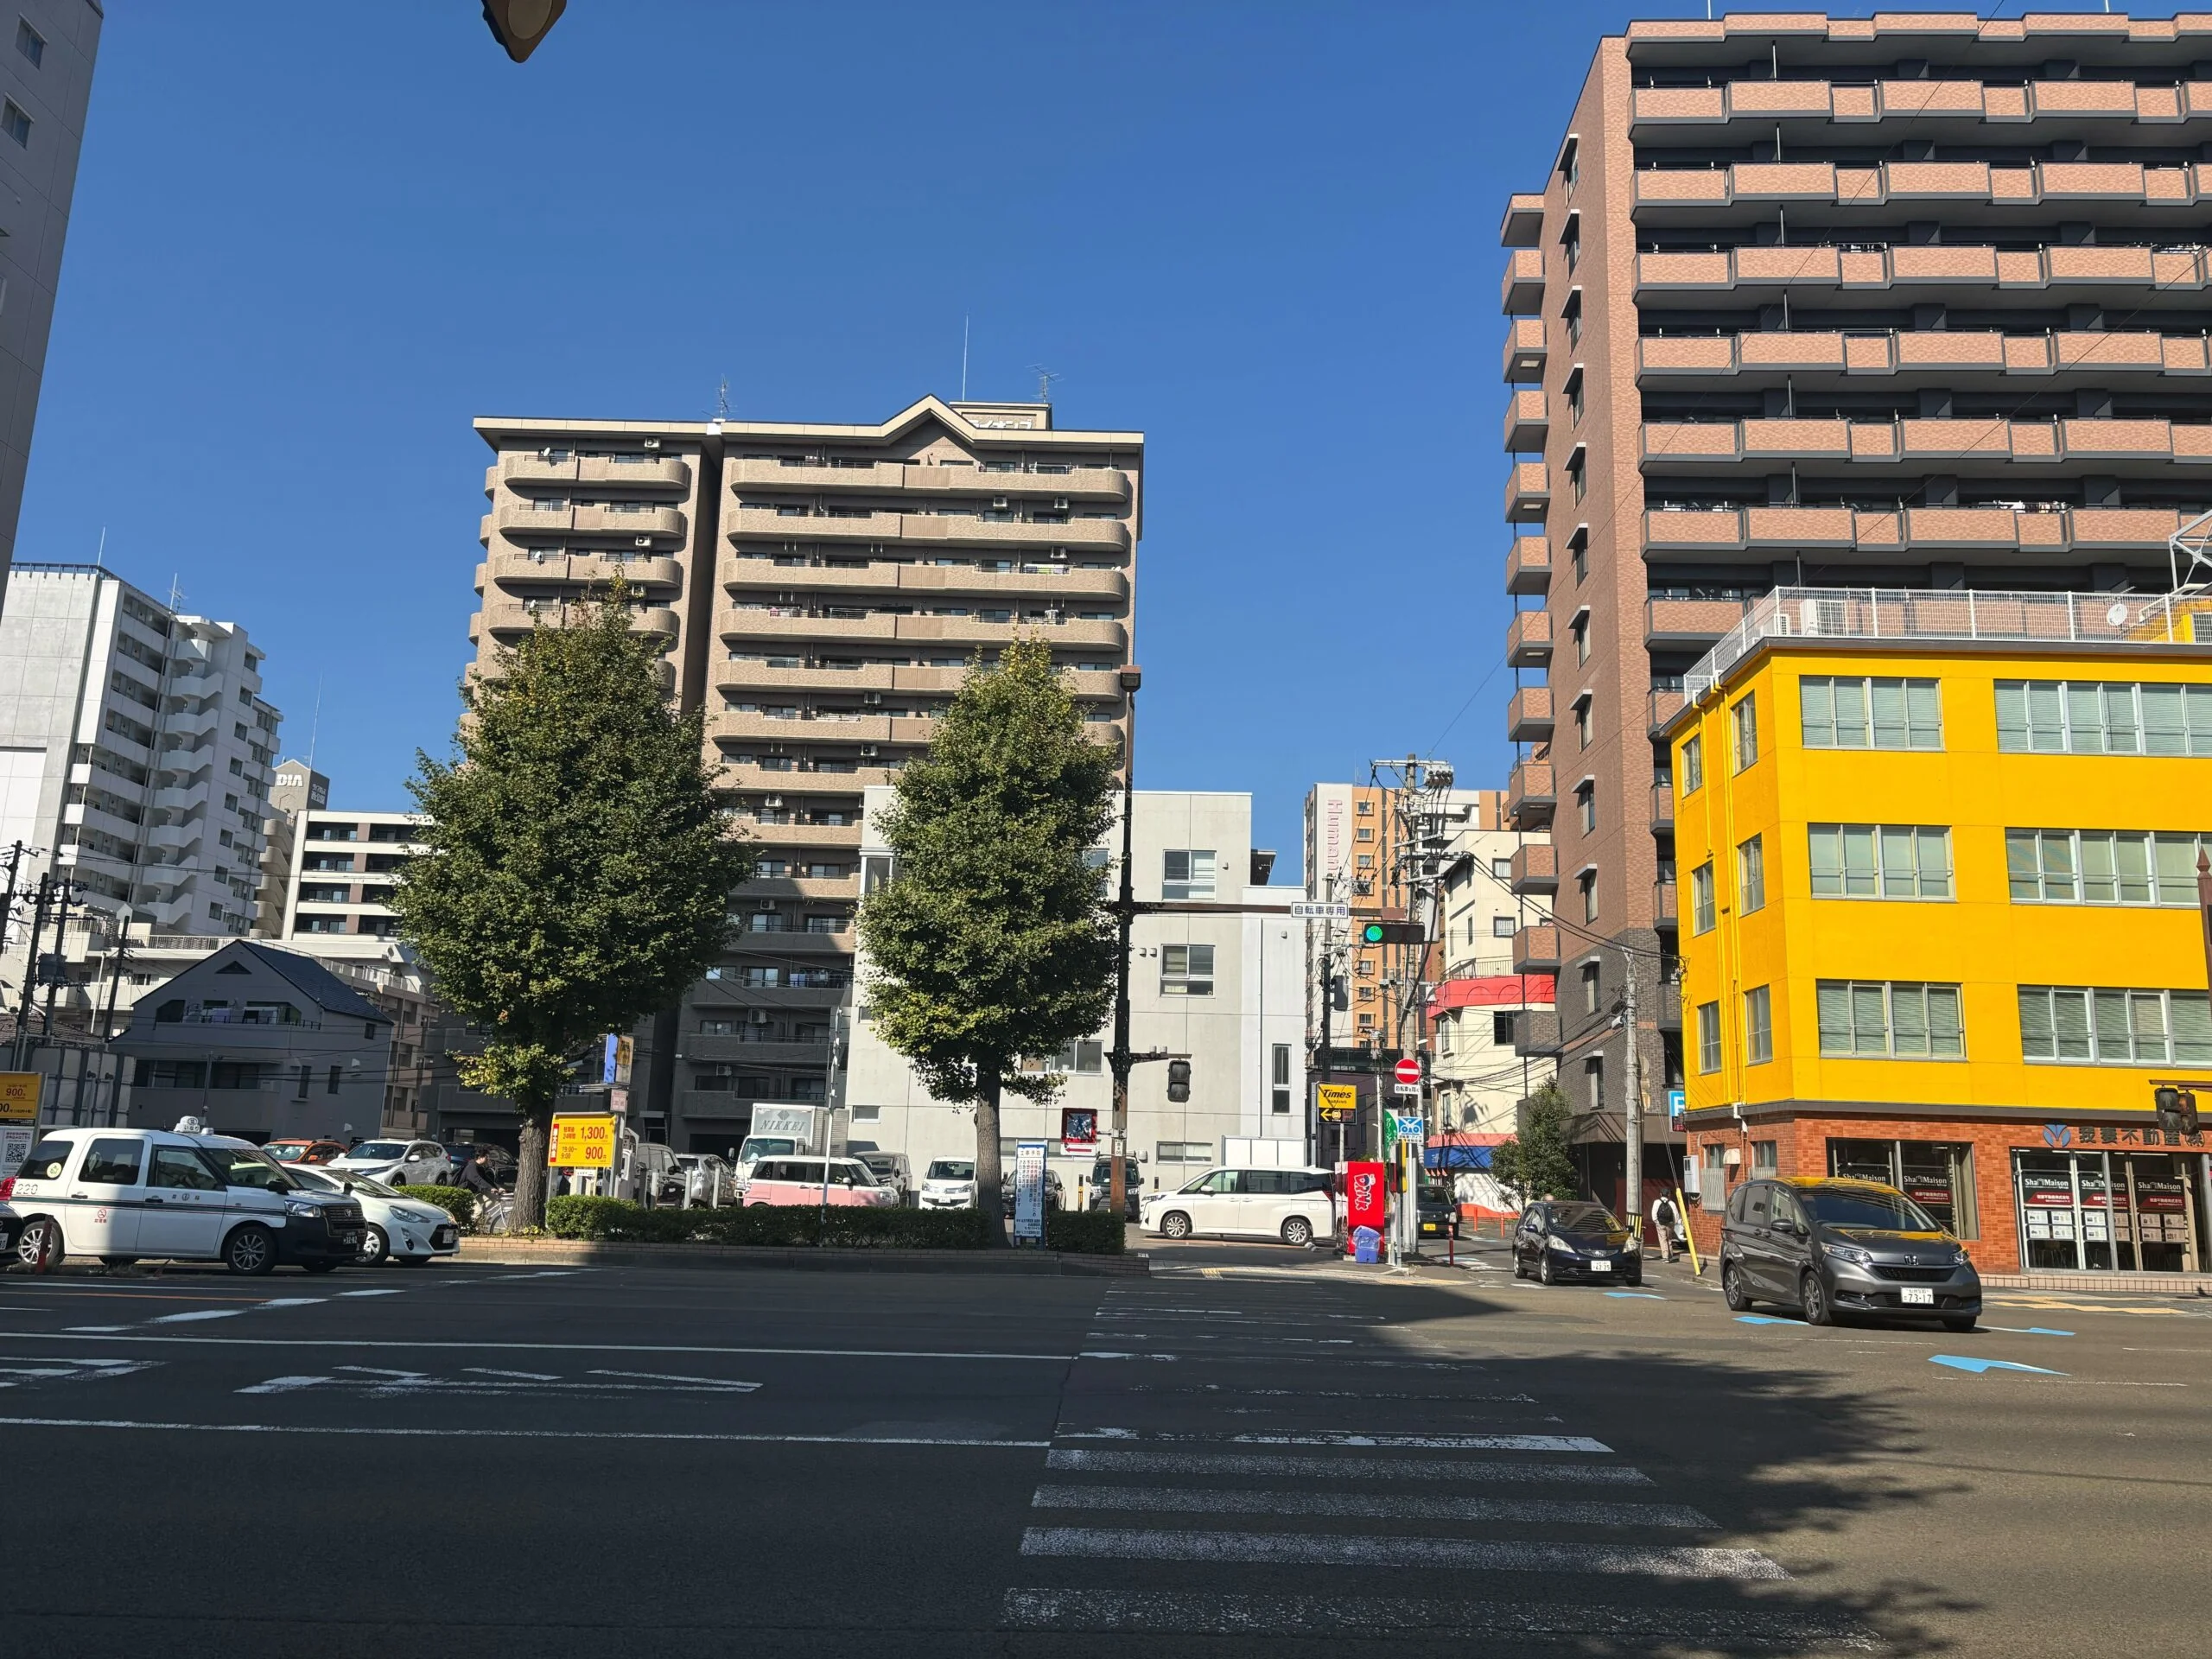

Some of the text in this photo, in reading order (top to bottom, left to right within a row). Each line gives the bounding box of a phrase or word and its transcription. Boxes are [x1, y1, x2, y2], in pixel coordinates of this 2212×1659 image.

[1294, 906, 1345, 916] 自転車専用
[1323, 1090, 1352, 1098] Times
[760, 1121, 807, 1131] NIKKEI
[16, 1184, 38, 1194] 220
